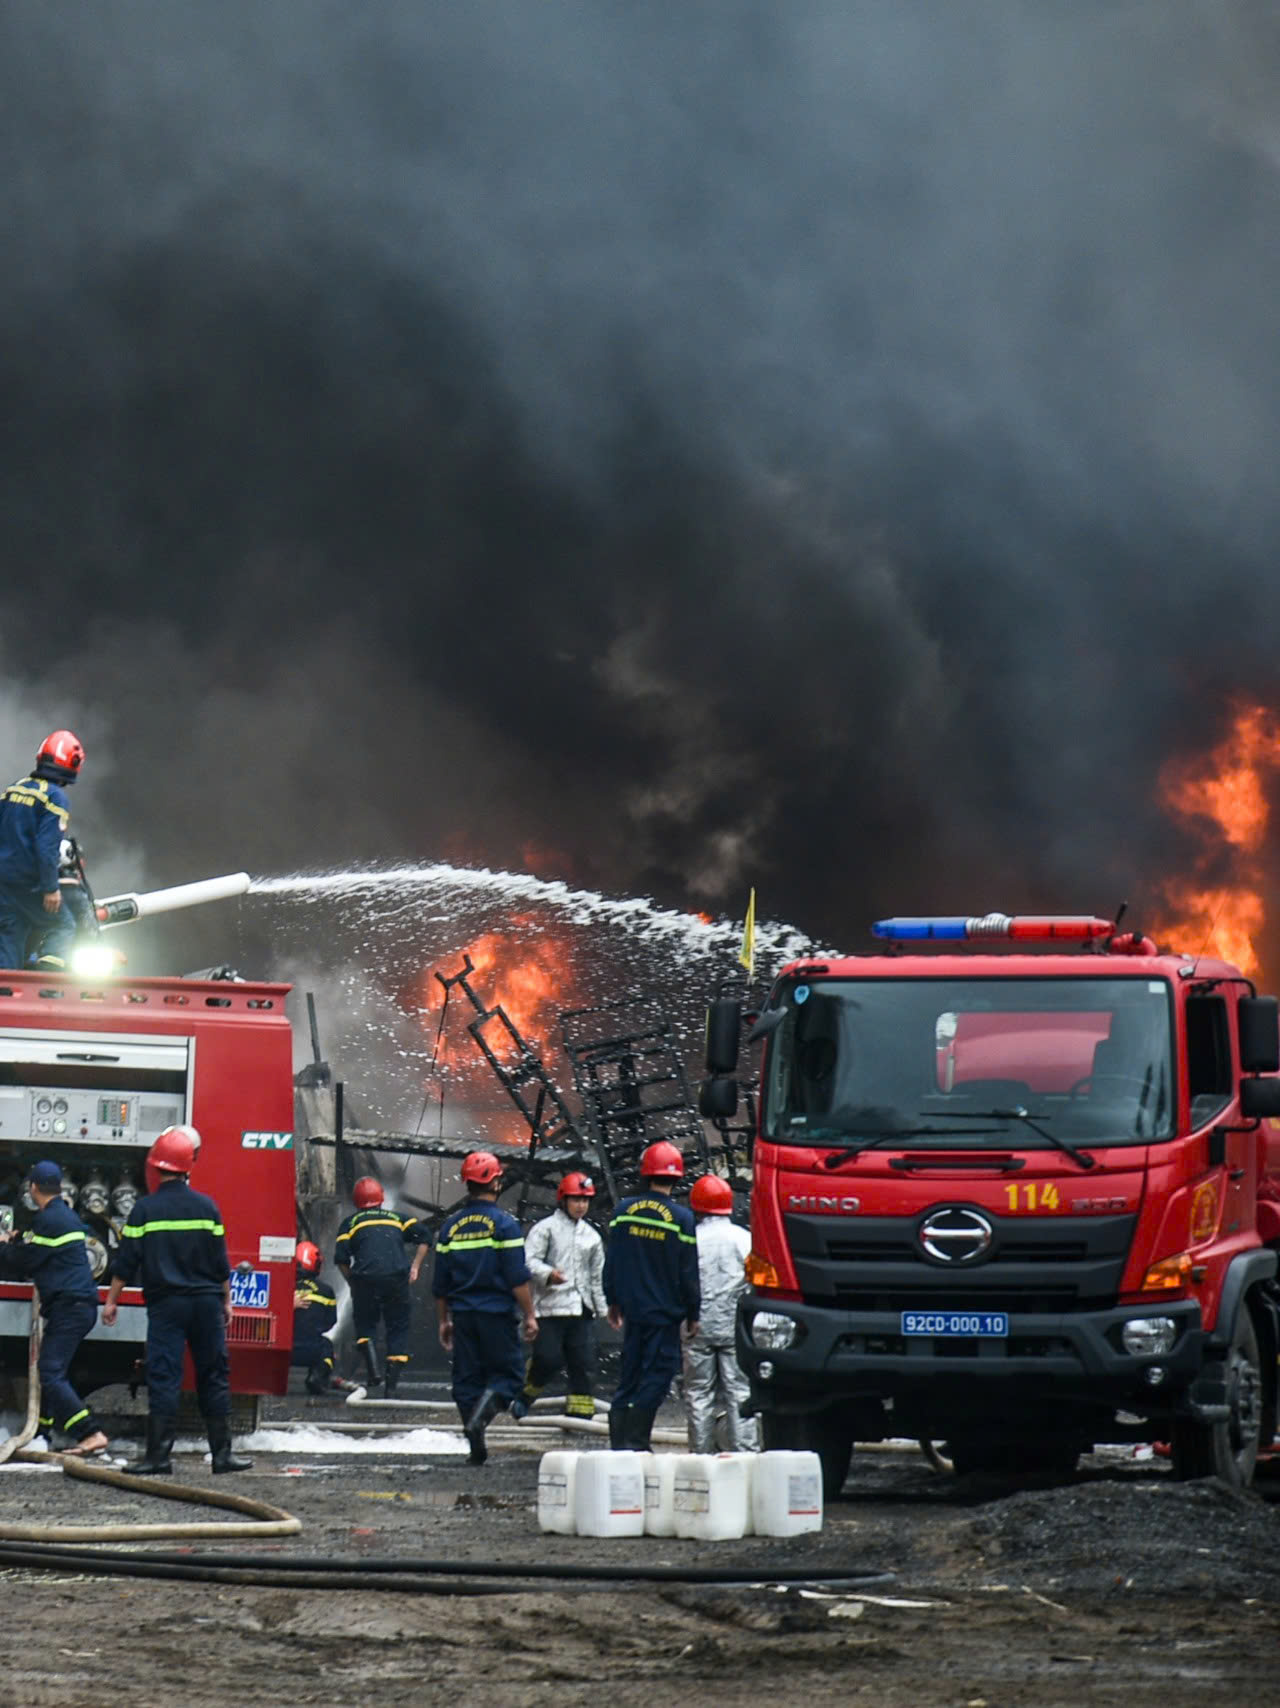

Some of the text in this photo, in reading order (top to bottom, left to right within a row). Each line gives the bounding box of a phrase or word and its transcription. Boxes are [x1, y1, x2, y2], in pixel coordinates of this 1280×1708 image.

[242, 1131, 293, 1149] CTV
[789, 1195, 860, 1210] HINO
[1004, 1183, 1059, 1210] 114
[231, 1272, 258, 1289] 43A
[229, 1289, 267, 1306] 04.40
